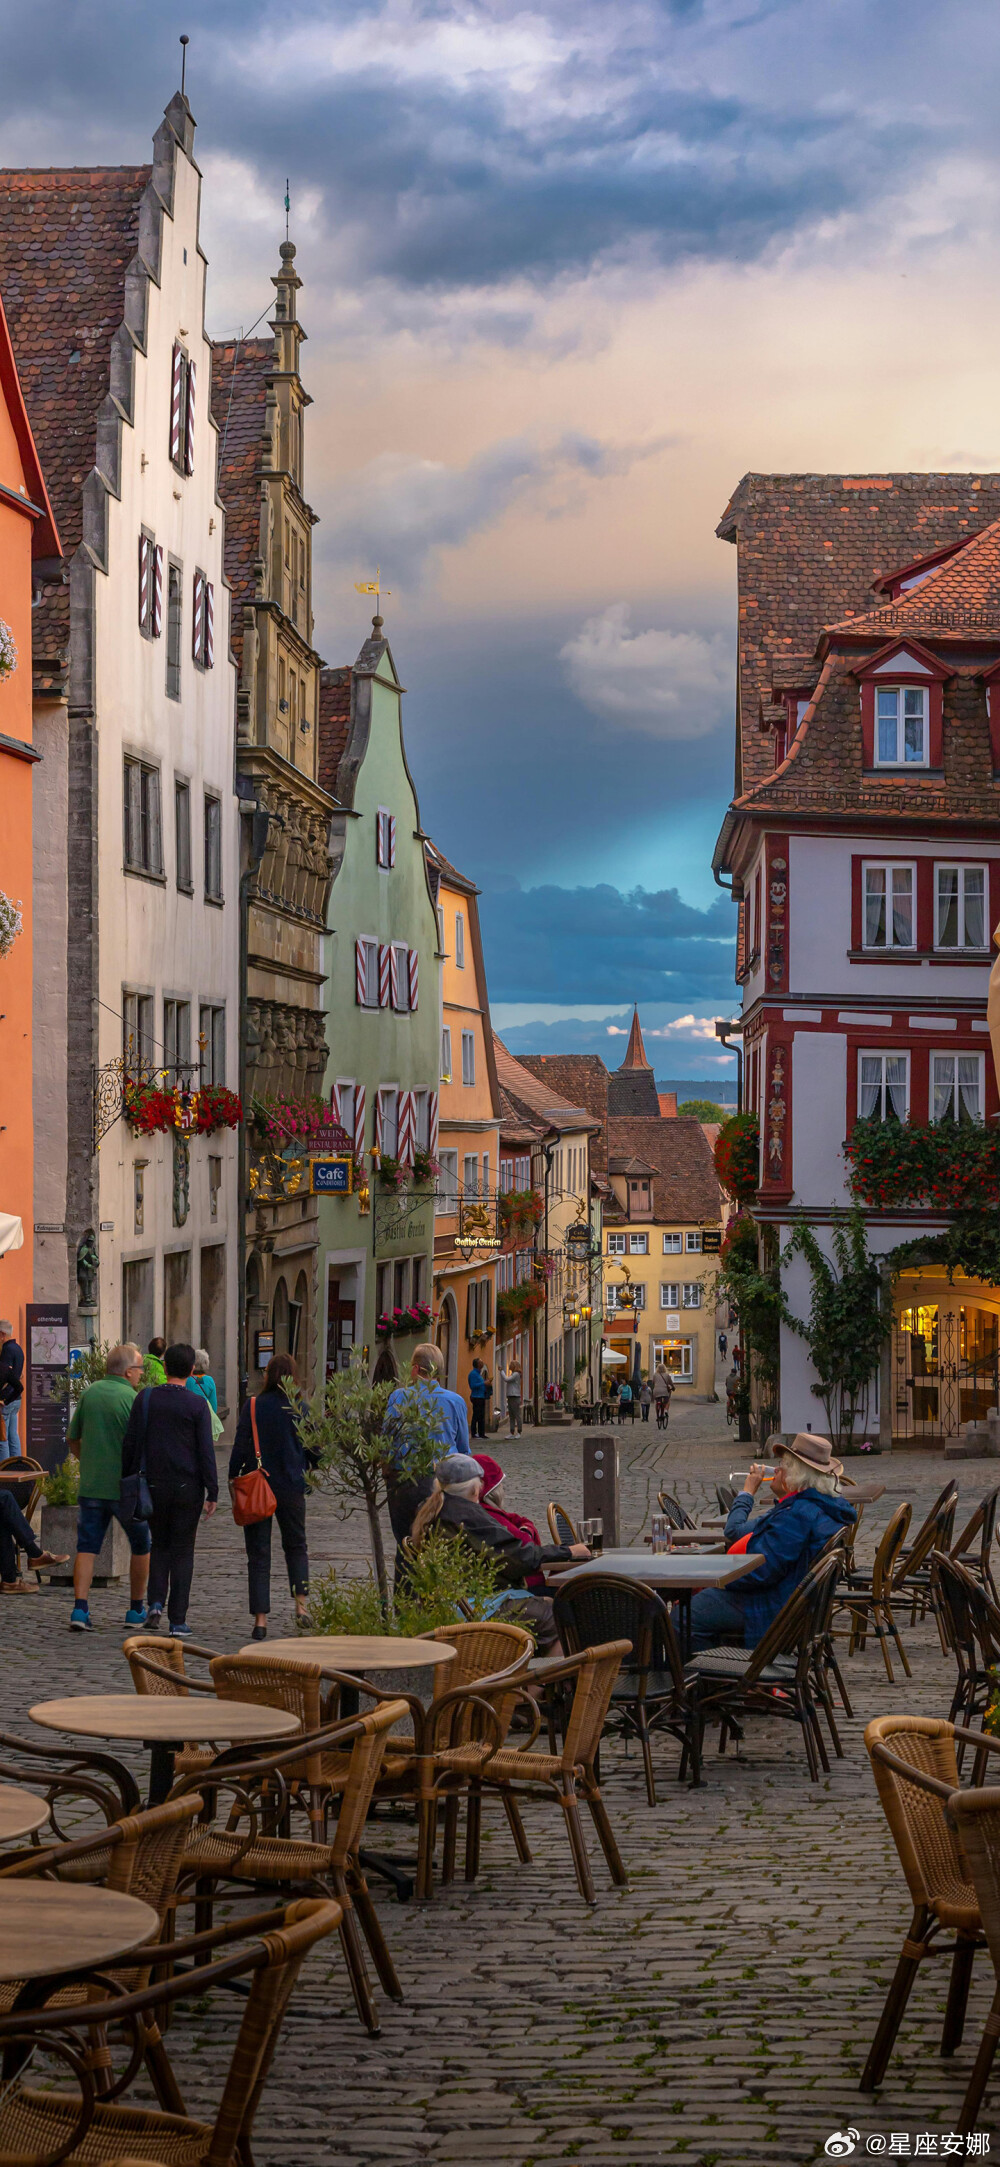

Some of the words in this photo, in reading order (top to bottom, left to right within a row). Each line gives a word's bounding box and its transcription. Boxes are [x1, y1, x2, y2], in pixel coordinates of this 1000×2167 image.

[319, 1130, 343, 1138] WEIN
[308, 1140, 353, 1149] RESTAURANT
[454, 1237, 478, 1247] Gasthof
